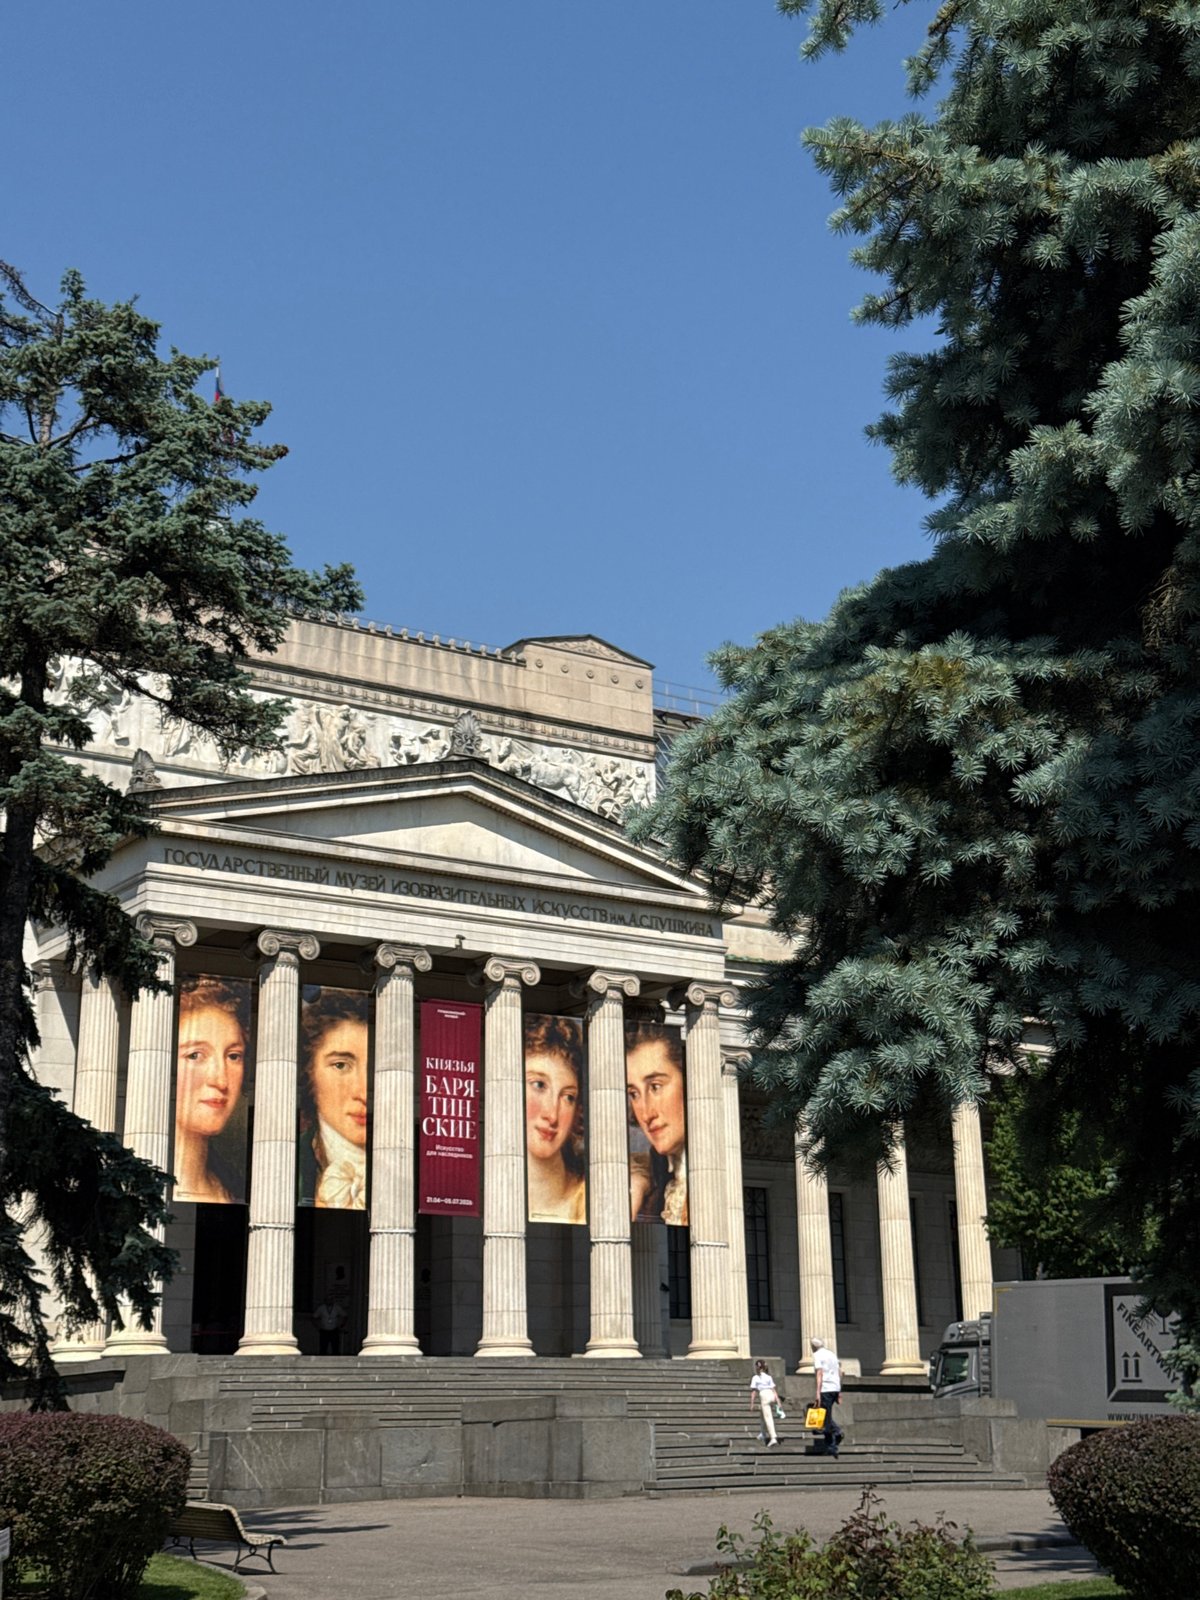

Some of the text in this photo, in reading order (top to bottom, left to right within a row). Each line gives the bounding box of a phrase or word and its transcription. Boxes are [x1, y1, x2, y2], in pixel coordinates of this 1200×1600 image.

[164, 848, 330, 885] ГОСУДАРСТВЕННЫЙ
[335, 869, 386, 893] МУЗЕЙ
[391, 879, 526, 912] ИЗОБРАЗИТЕЛЬНЫХ
[532, 899, 608, 923] ИСКУССТВ
[426, 1057, 475, 1073] КНЯЗЬЯ
[425, 1075, 480, 1098] БАРЯ-
[428, 1096, 476, 1118] ТИН-
[422, 1117, 476, 1140] СКИЕ
[1116, 1302, 1180, 1384] FINEARTWAY
